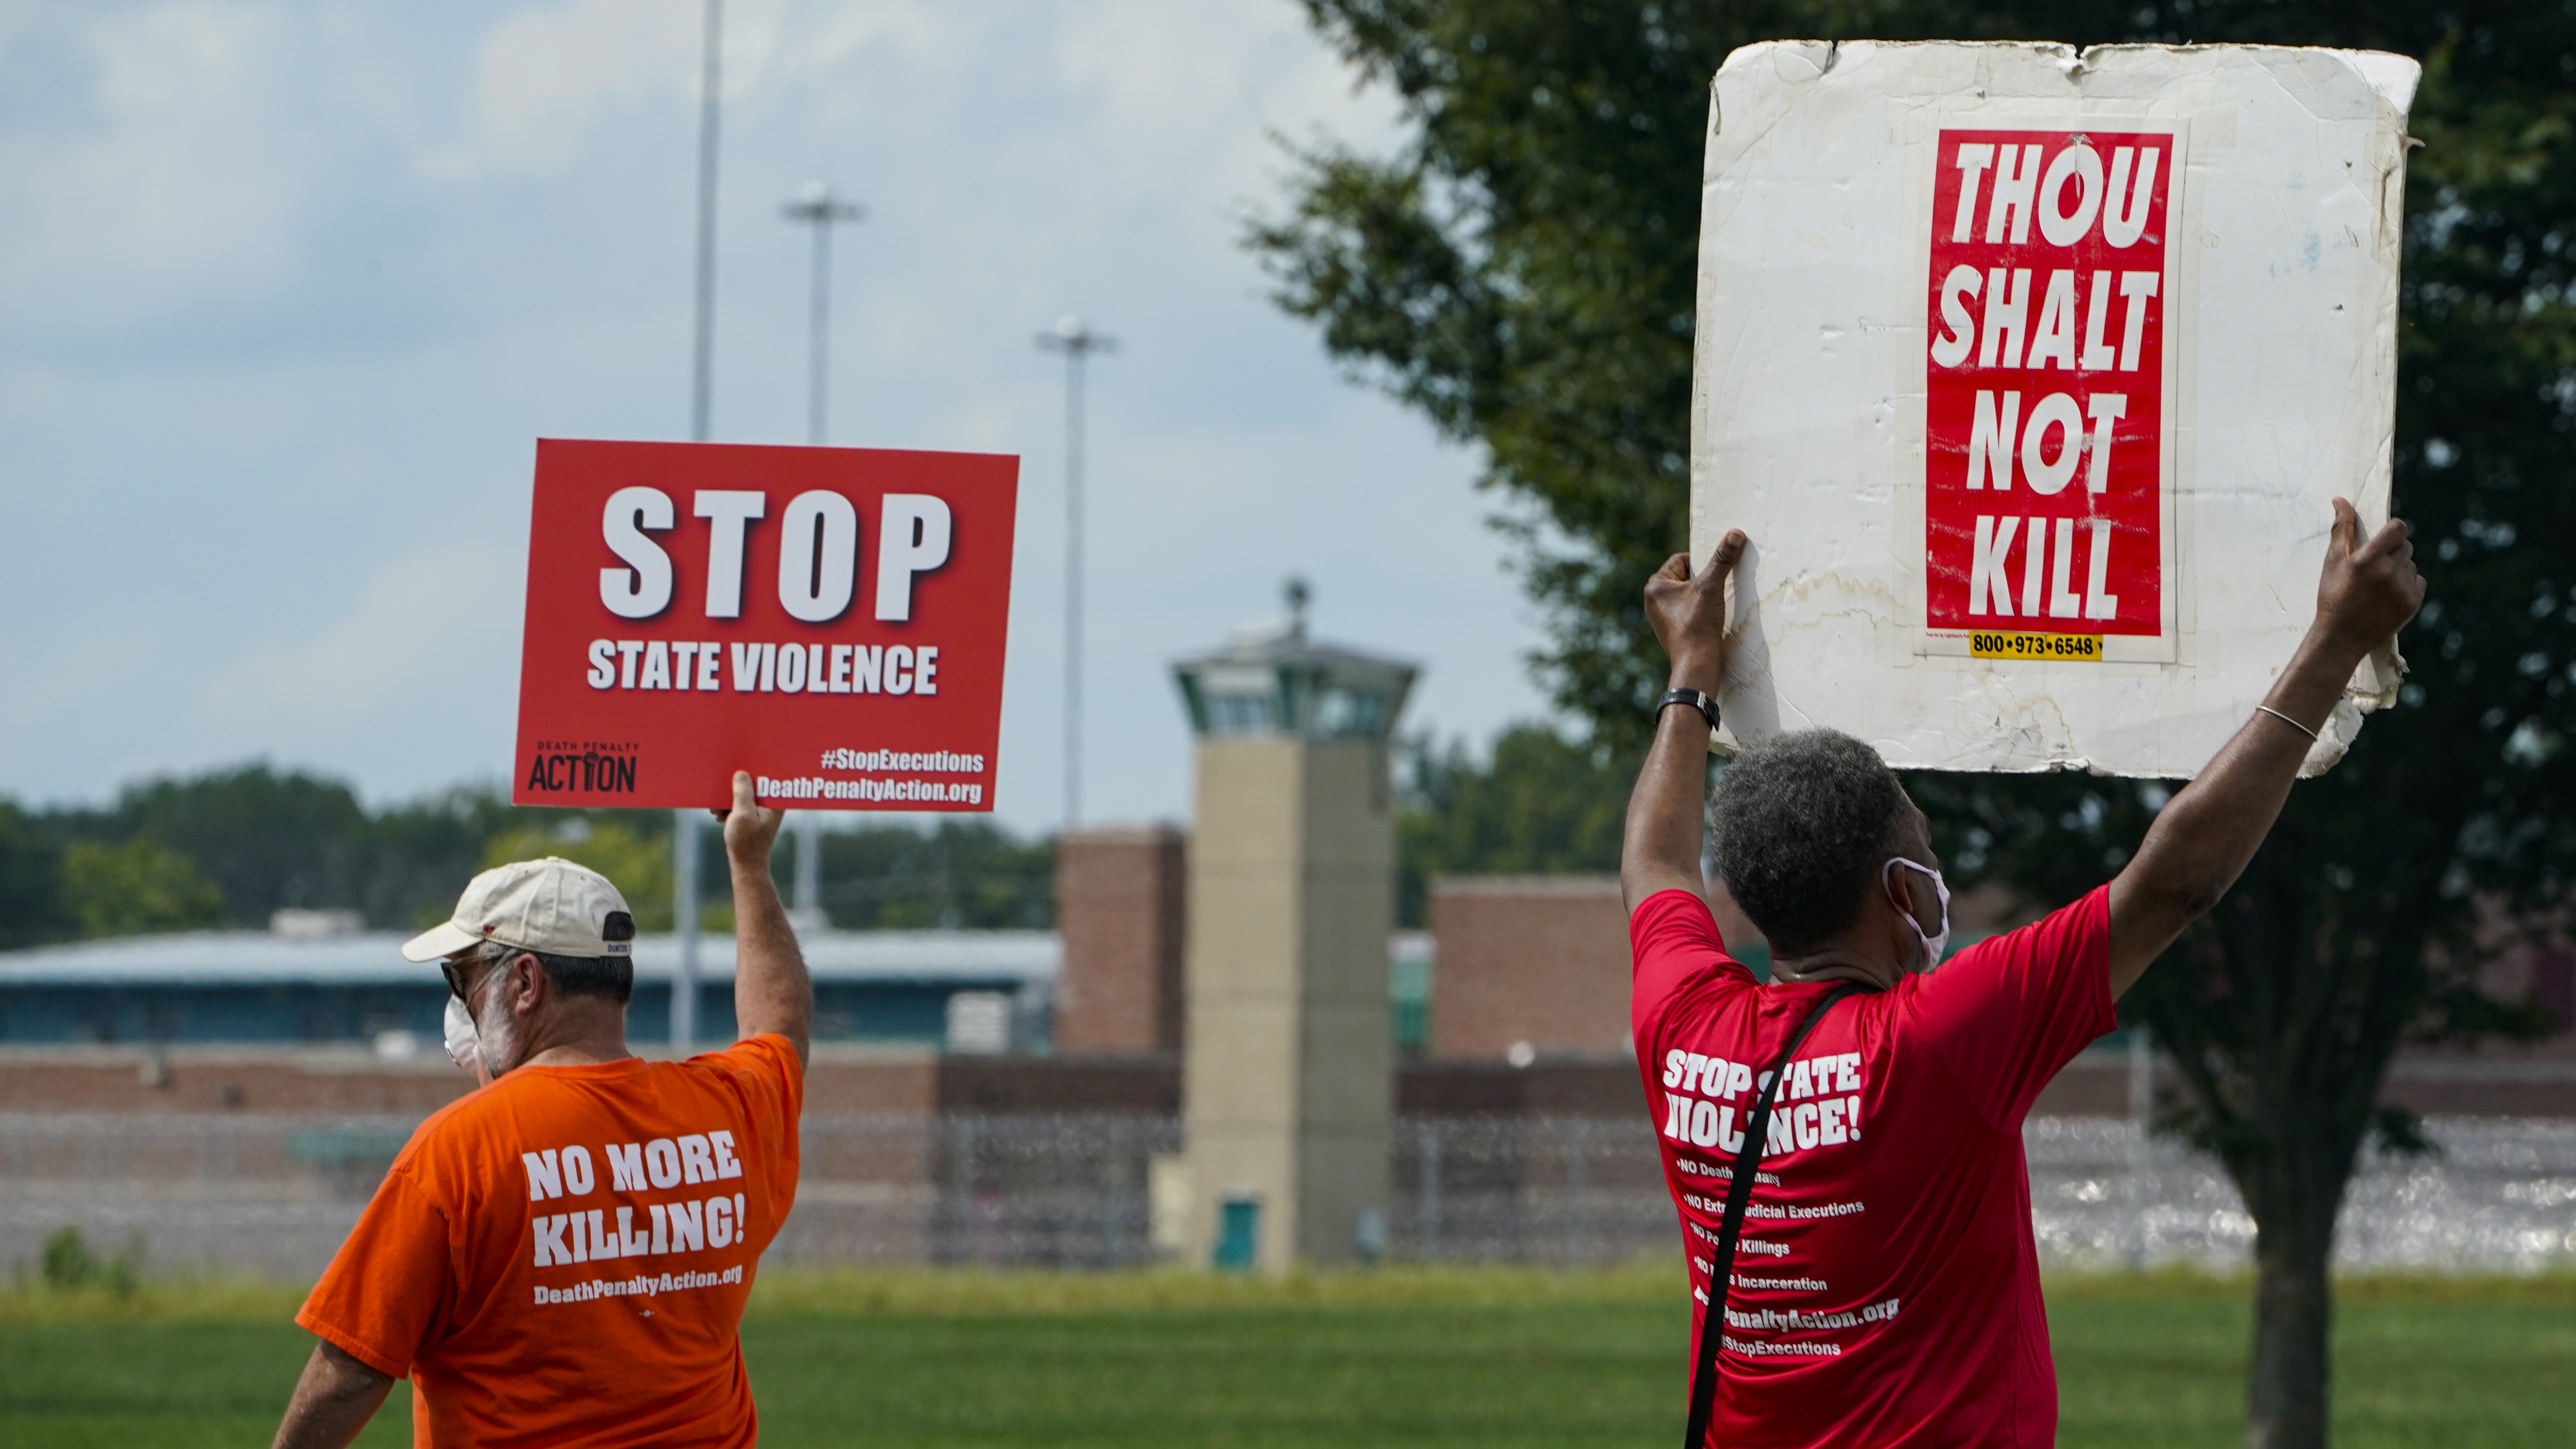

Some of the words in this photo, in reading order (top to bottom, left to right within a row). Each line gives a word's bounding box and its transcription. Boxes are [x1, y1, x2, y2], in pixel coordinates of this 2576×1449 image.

[1952, 143, 2160, 248] THOU
[1930, 264, 2160, 372] SHALT
[1966, 389, 2128, 495] NOT
[599, 486, 952, 622] STOP
[1968, 515, 2118, 620] KILL
[587, 639, 721, 691] STATE
[730, 642, 938, 695] VIOLENCE
[527, 751, 637, 793] ACTION
[537, 741, 577, 750] DEATH
[583, 742, 639, 752] PENALTY
[820, 747, 984, 772] #StopExecutions
[756, 776, 982, 805] DeathPenaltyAction.org
[1663, 1049, 1752, 1101] STOP
[1663, 1090, 1861, 1157] VIOLNCE!
[522, 1144, 595, 1201] NO
[605, 1130, 743, 1192] MORE
[1699, 1162, 1734, 1180] Death
[532, 1192, 745, 1266] KILLING!
[1704, 1198, 1786, 1219] Extrudicial
[1788, 1201, 1865, 1219] Executions
[1742, 1239, 1791, 1258] Killings
[534, 1264, 743, 1305] DeathPenaltyAction.org
[1738, 1273, 1828, 1291] Incarceration
